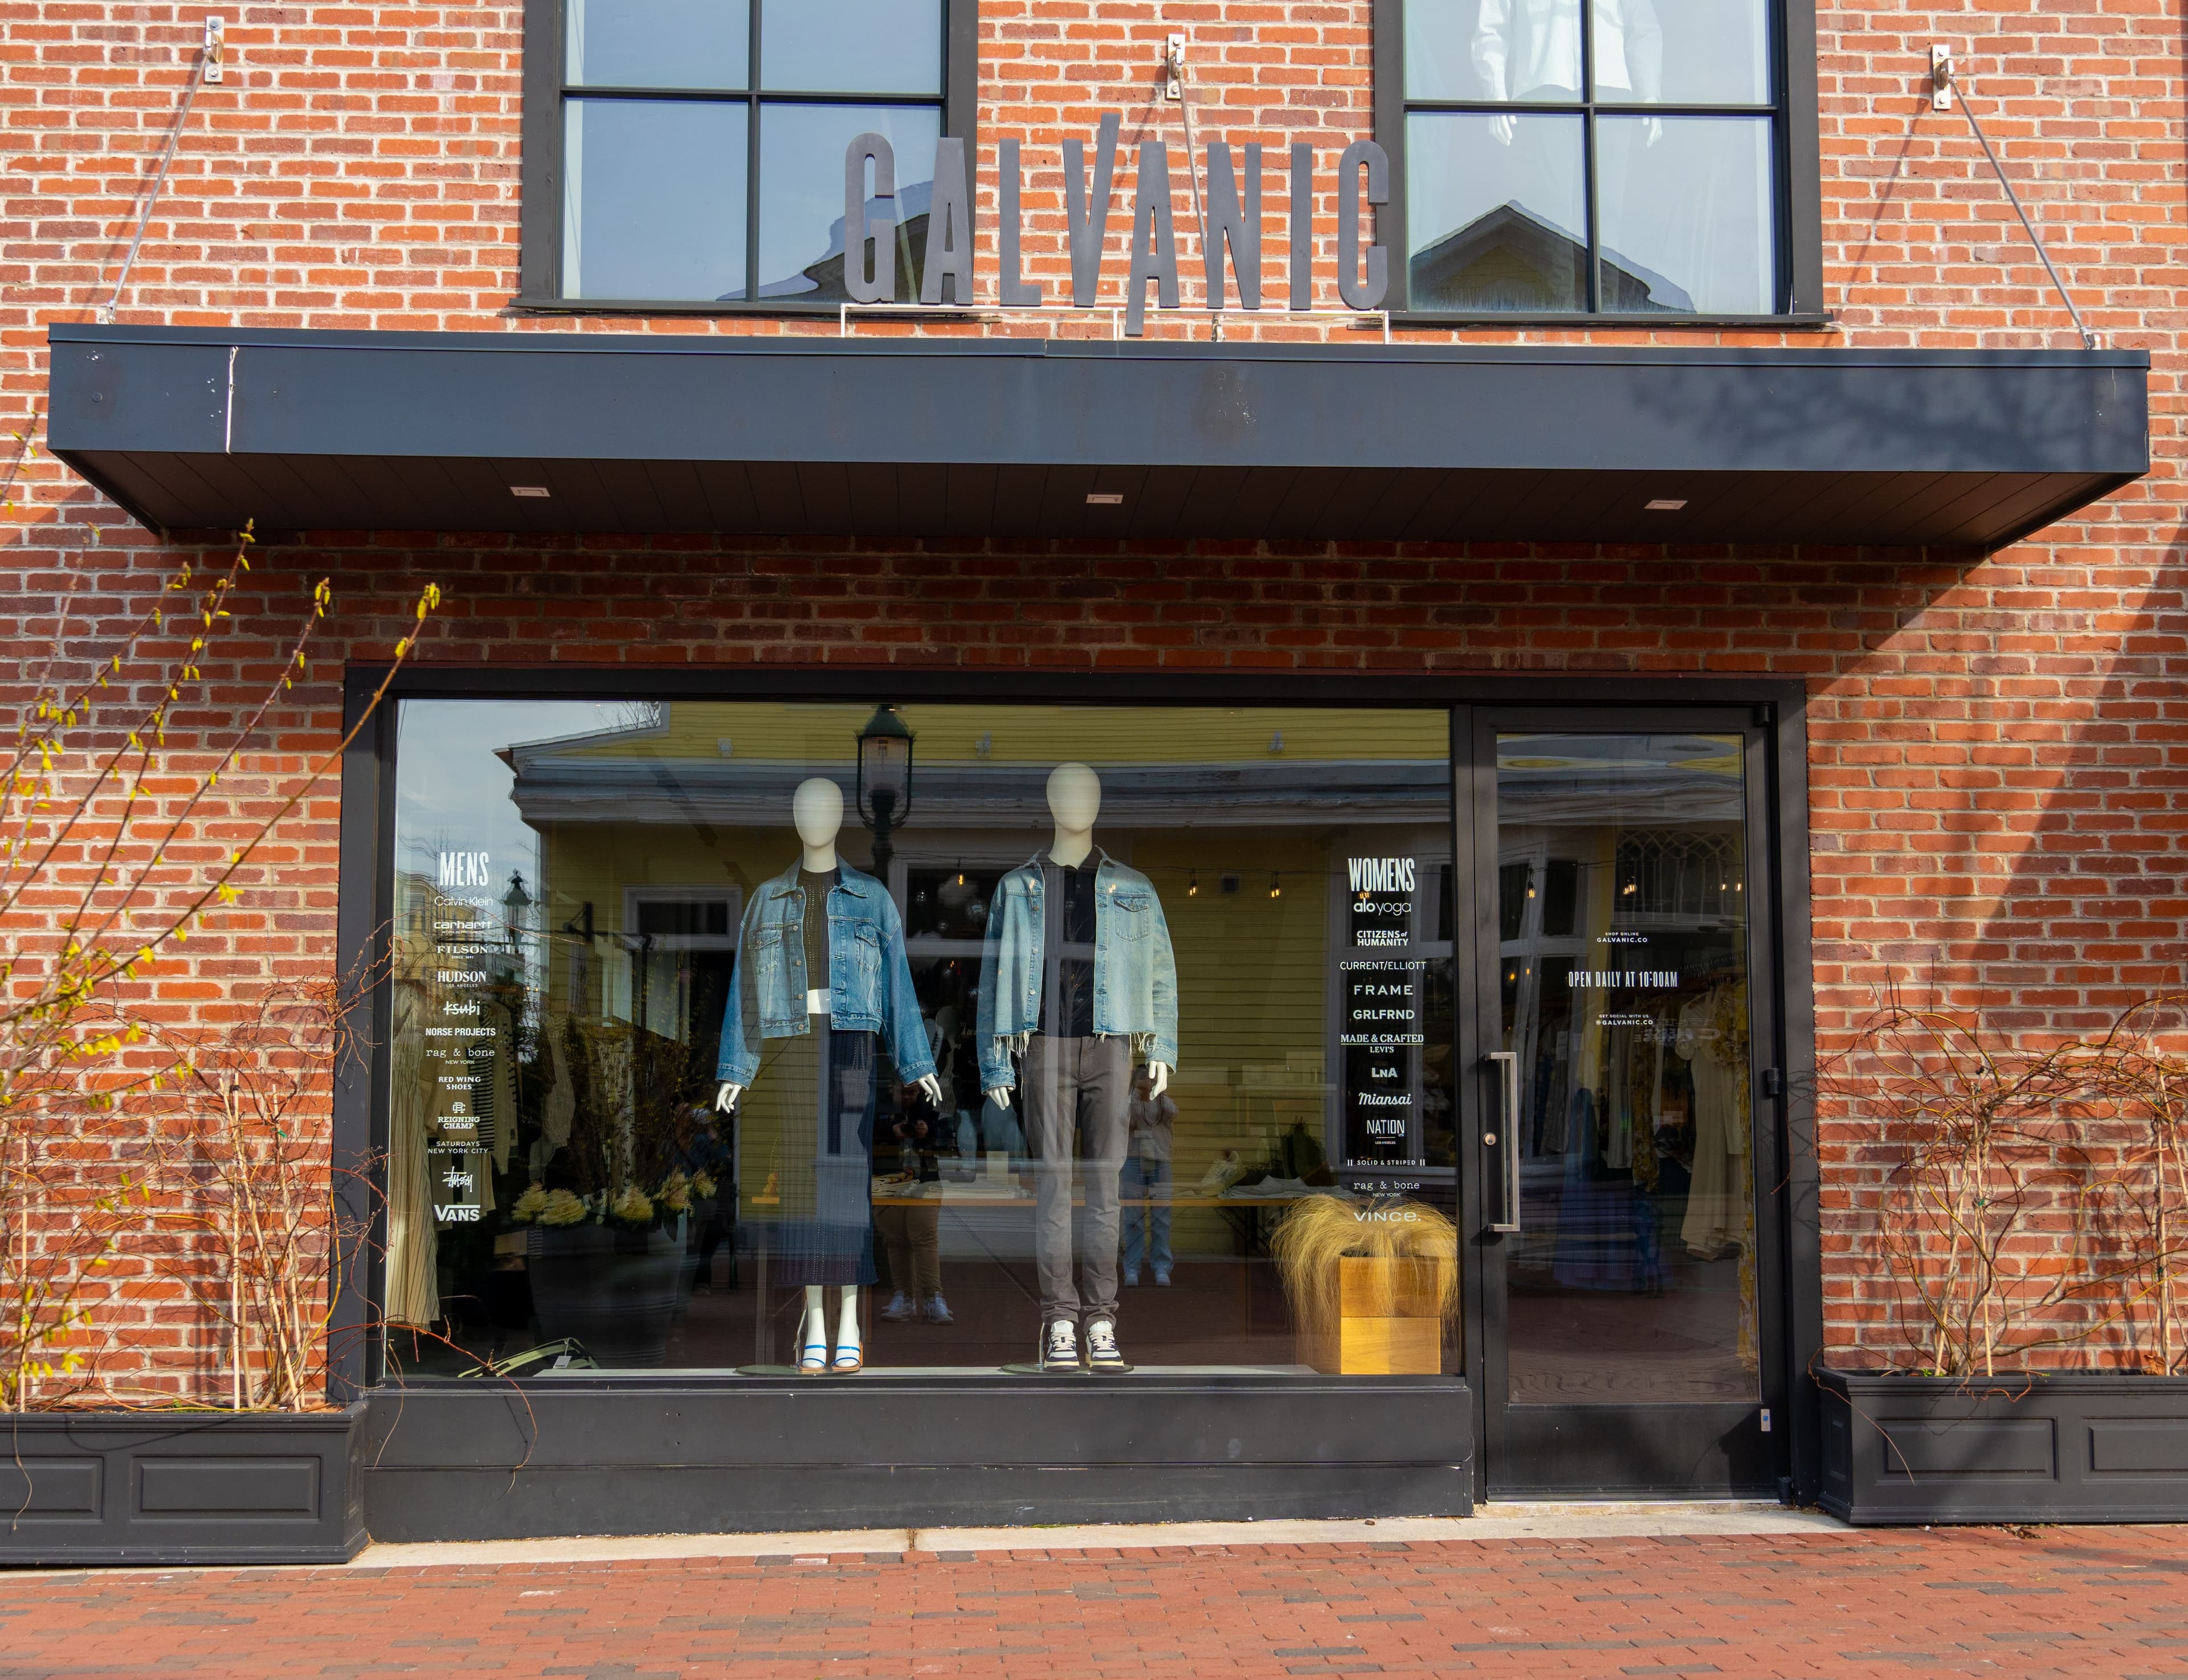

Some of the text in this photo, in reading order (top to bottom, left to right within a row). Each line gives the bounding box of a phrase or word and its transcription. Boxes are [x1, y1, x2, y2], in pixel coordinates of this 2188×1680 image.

[845, 113, 1389, 337] GALVANIC
[439, 852, 489, 886] MENS
[1348, 858, 1415, 892] WOMENS
[434, 896, 493, 906] Calvin Klein
[434, 920, 493, 929] carhartt
[437, 945, 488, 954] FILSON
[1340, 961, 1426, 971] CURRENT/ELLIOTT
[437, 971, 487, 982] HUDSON
[1569, 971, 1677, 987] OPEN DAILY AT 10:00AM
[1354, 985, 1413, 995] FRAME
[1353, 1009, 1415, 1020] GRLFRND
[425, 1027, 496, 1036] NORSE PROJECTS
[1341, 1034, 1424, 1043] MADE & CRAFTED
[426, 1048, 495, 1058] rag & bone
[1358, 1092, 1412, 1106] Miansai
[1367, 1119, 1405, 1134] NATION
[1353, 1181, 1420, 1191] rag & bone
[434, 1204, 480, 1221] VANS
